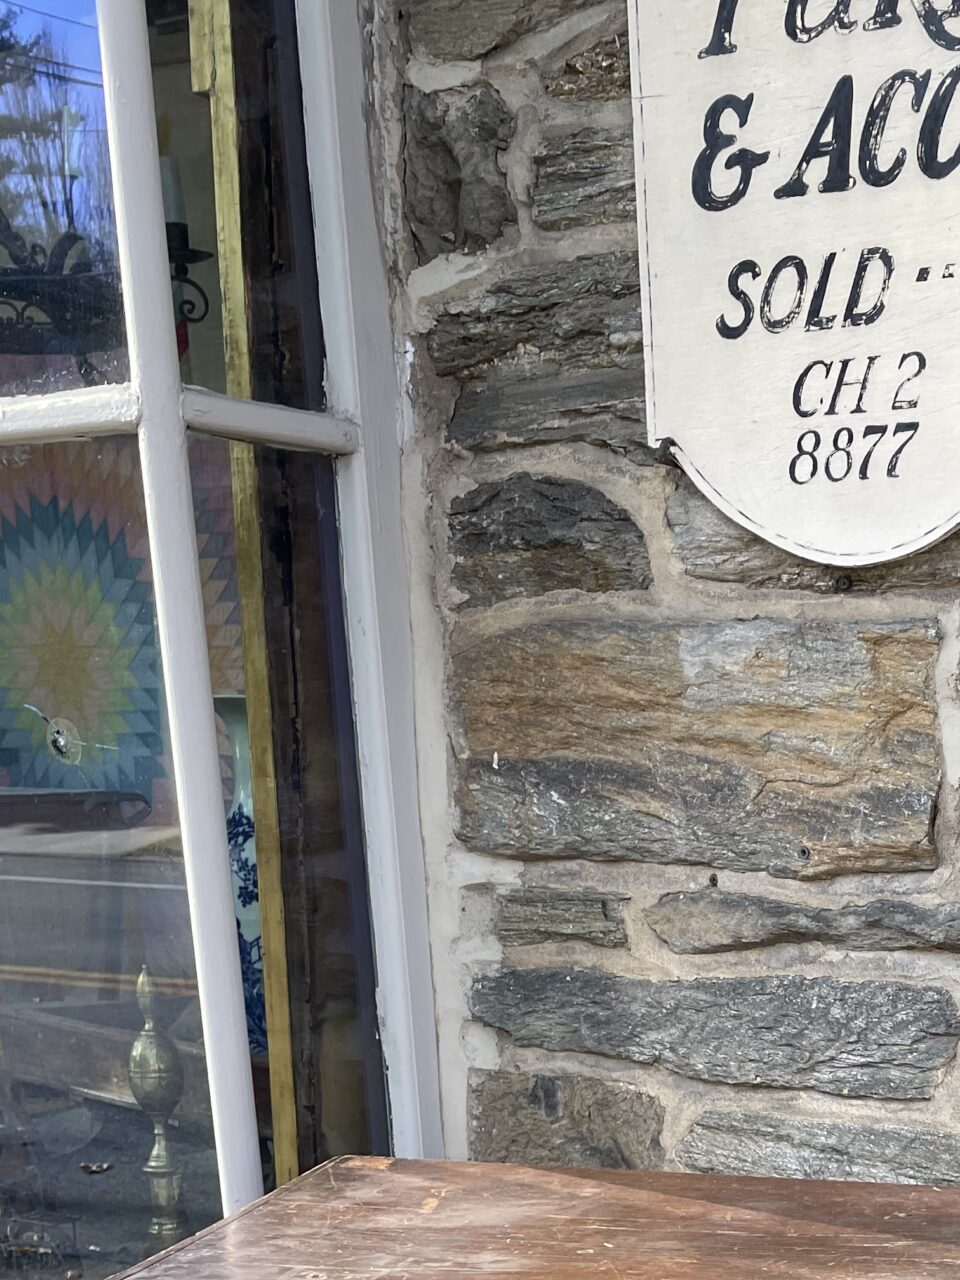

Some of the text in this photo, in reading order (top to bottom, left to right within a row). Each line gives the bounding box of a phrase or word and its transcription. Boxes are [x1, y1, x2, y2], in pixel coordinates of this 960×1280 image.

[690, 92, 771, 212] &
[714, 246, 895, 341] SOLD
[790, 351, 928, 418] CH 2
[787, 421, 920, 486] 8877
